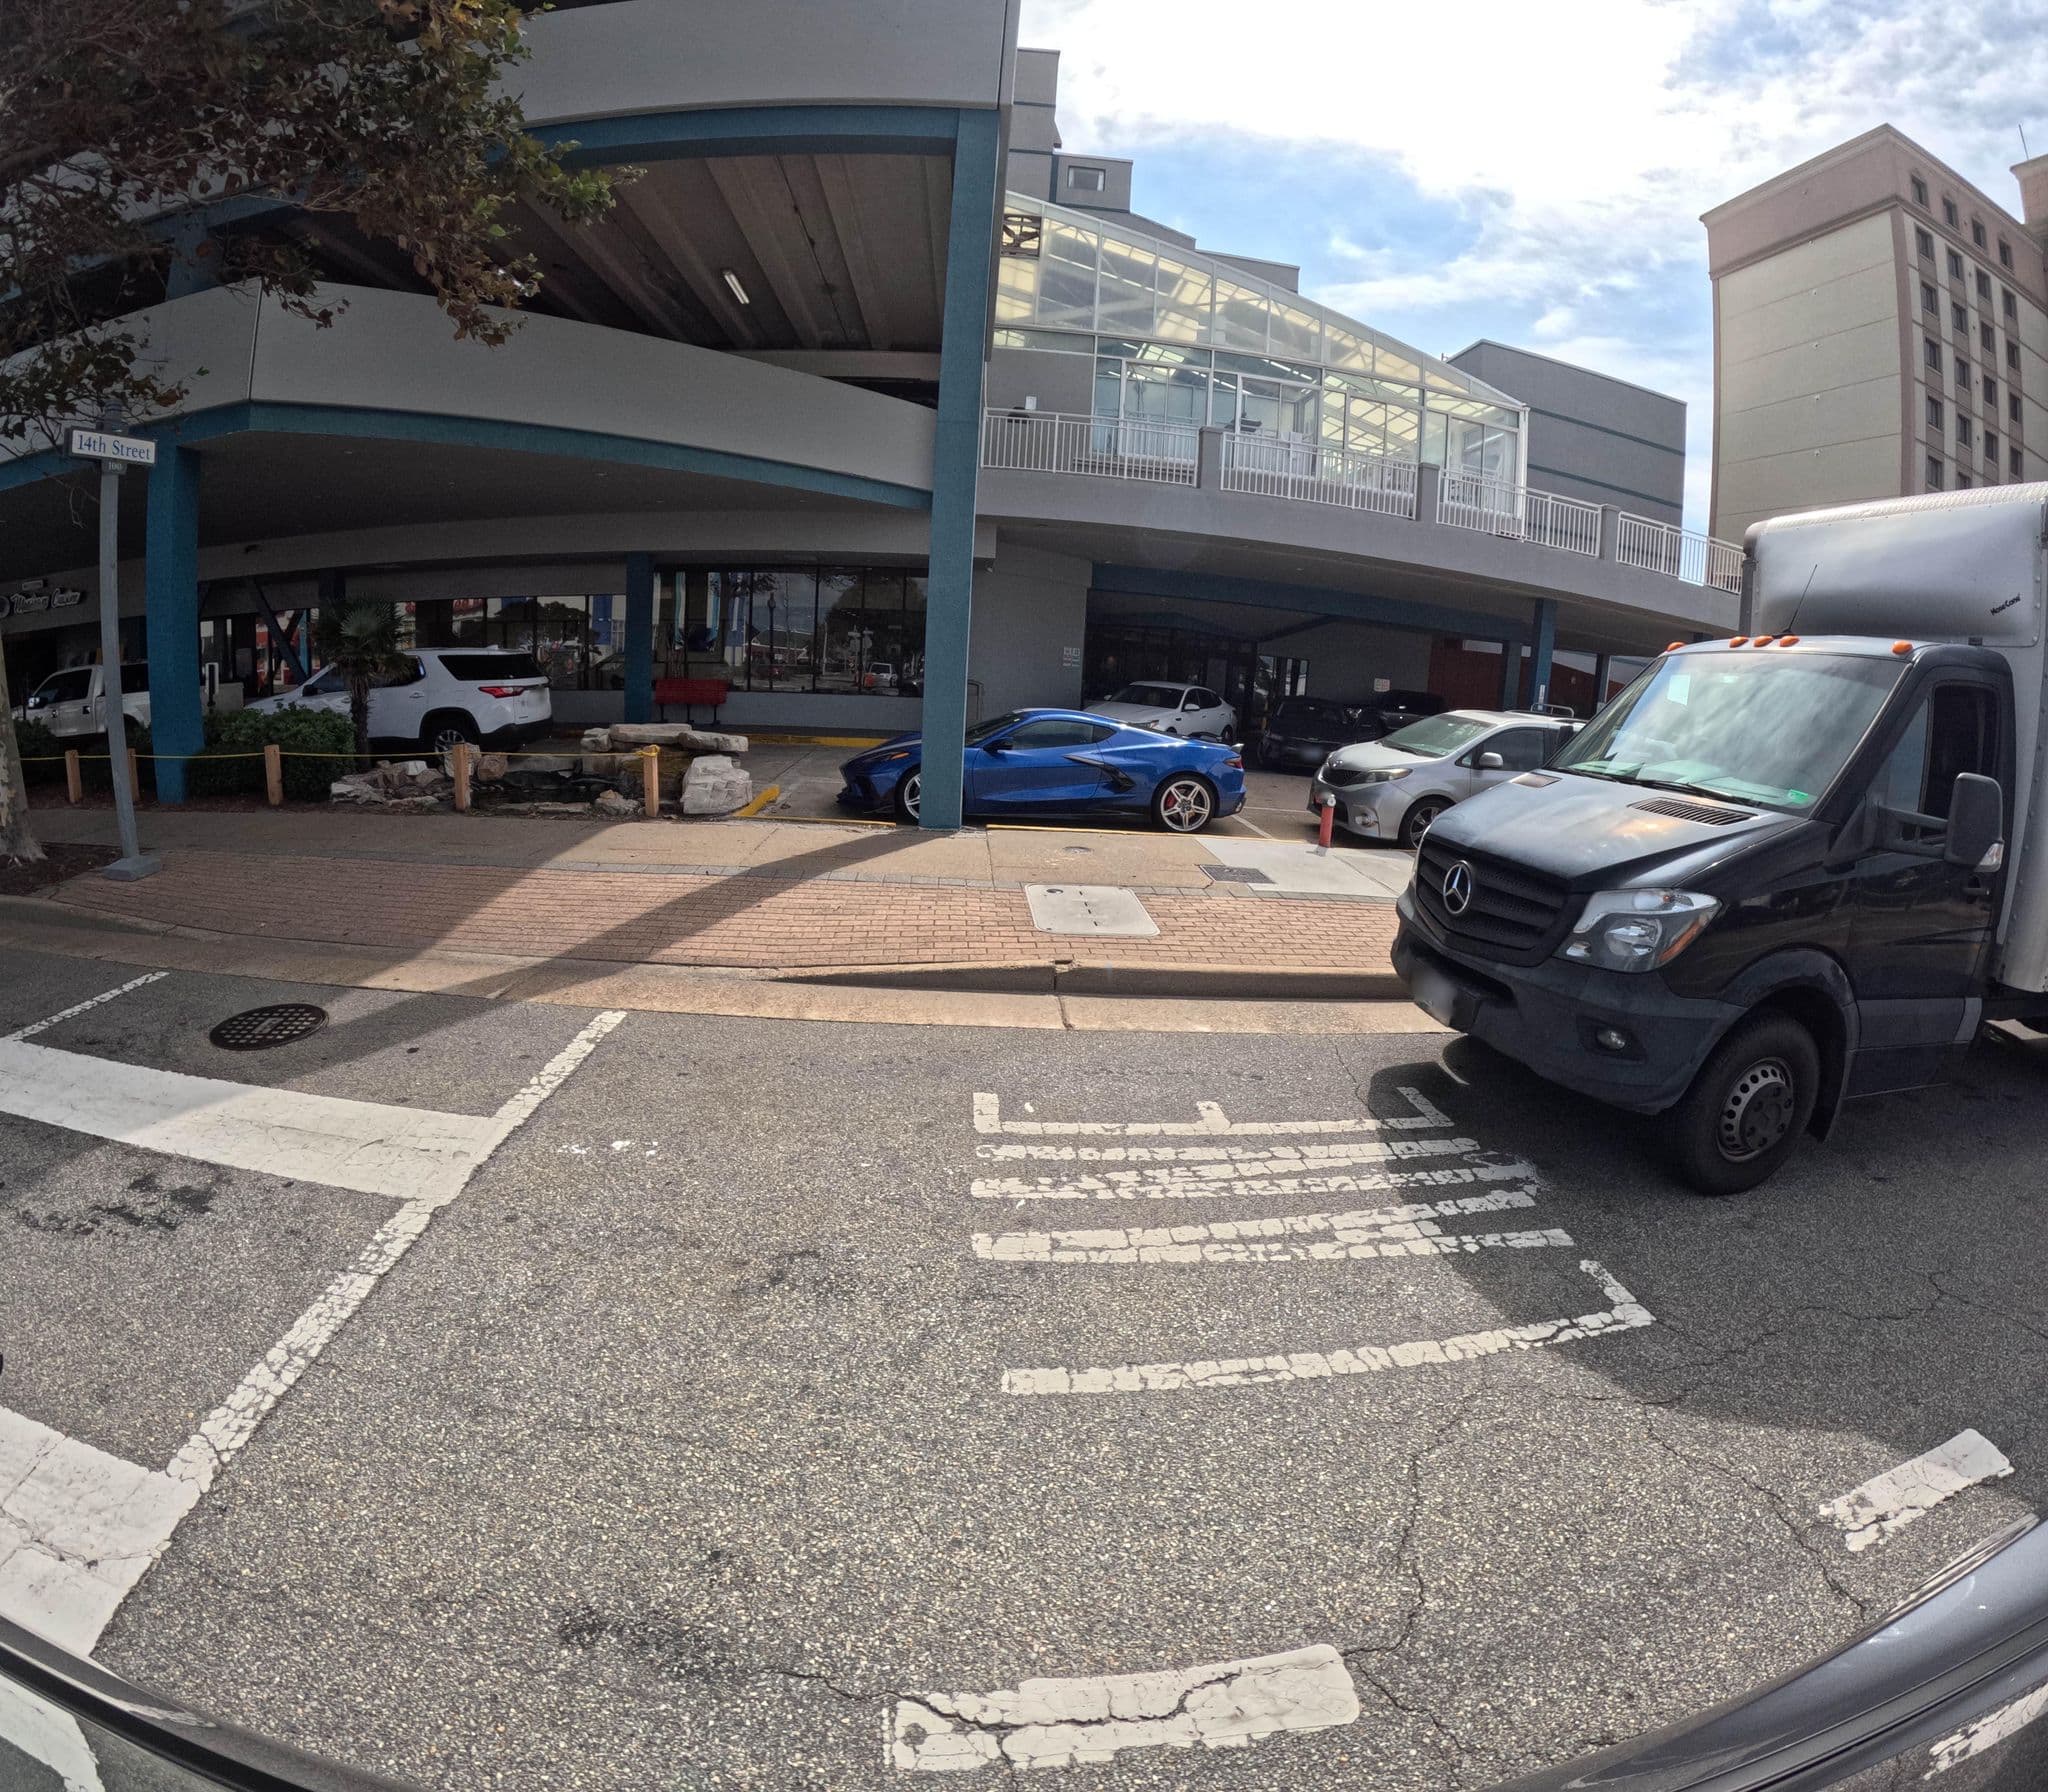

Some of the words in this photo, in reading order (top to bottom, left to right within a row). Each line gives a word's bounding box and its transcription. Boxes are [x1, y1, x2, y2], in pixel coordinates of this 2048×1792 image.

[77, 434, 106, 454] 14th
[112, 439, 151, 460] Street
[970, 1086, 1656, 1396] LANE
